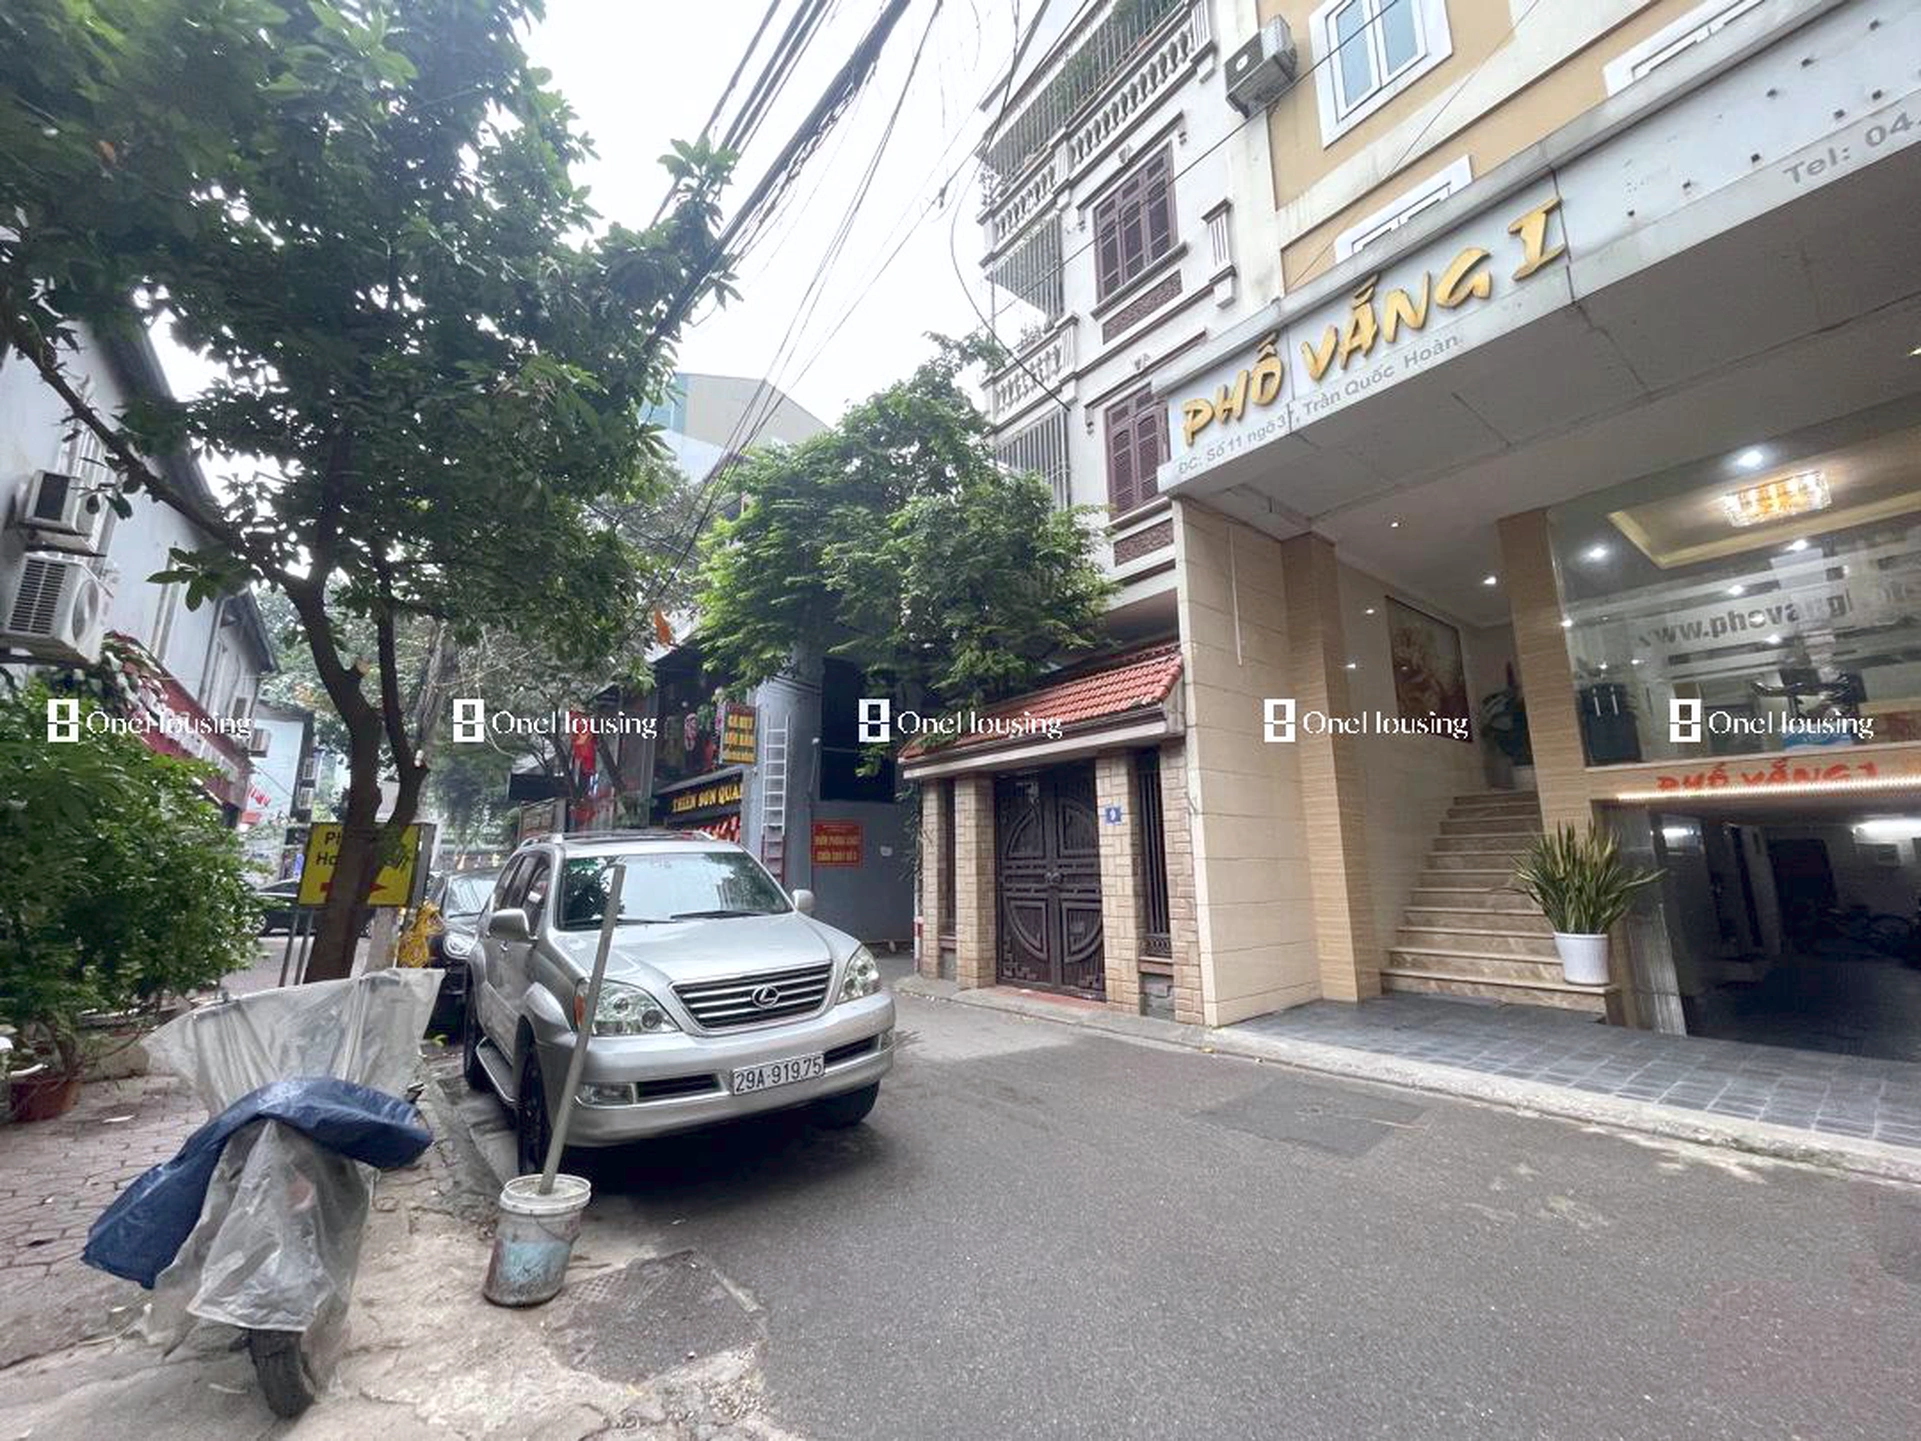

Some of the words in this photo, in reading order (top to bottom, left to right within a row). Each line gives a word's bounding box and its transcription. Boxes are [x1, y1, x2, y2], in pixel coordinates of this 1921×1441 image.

[1783, 147, 1850, 183] Tel:
[1183, 329, 1285, 447] PHỐ
[1301, 272, 1492, 382] VẮNG
[1344, 362, 1396, 396] Quốc
